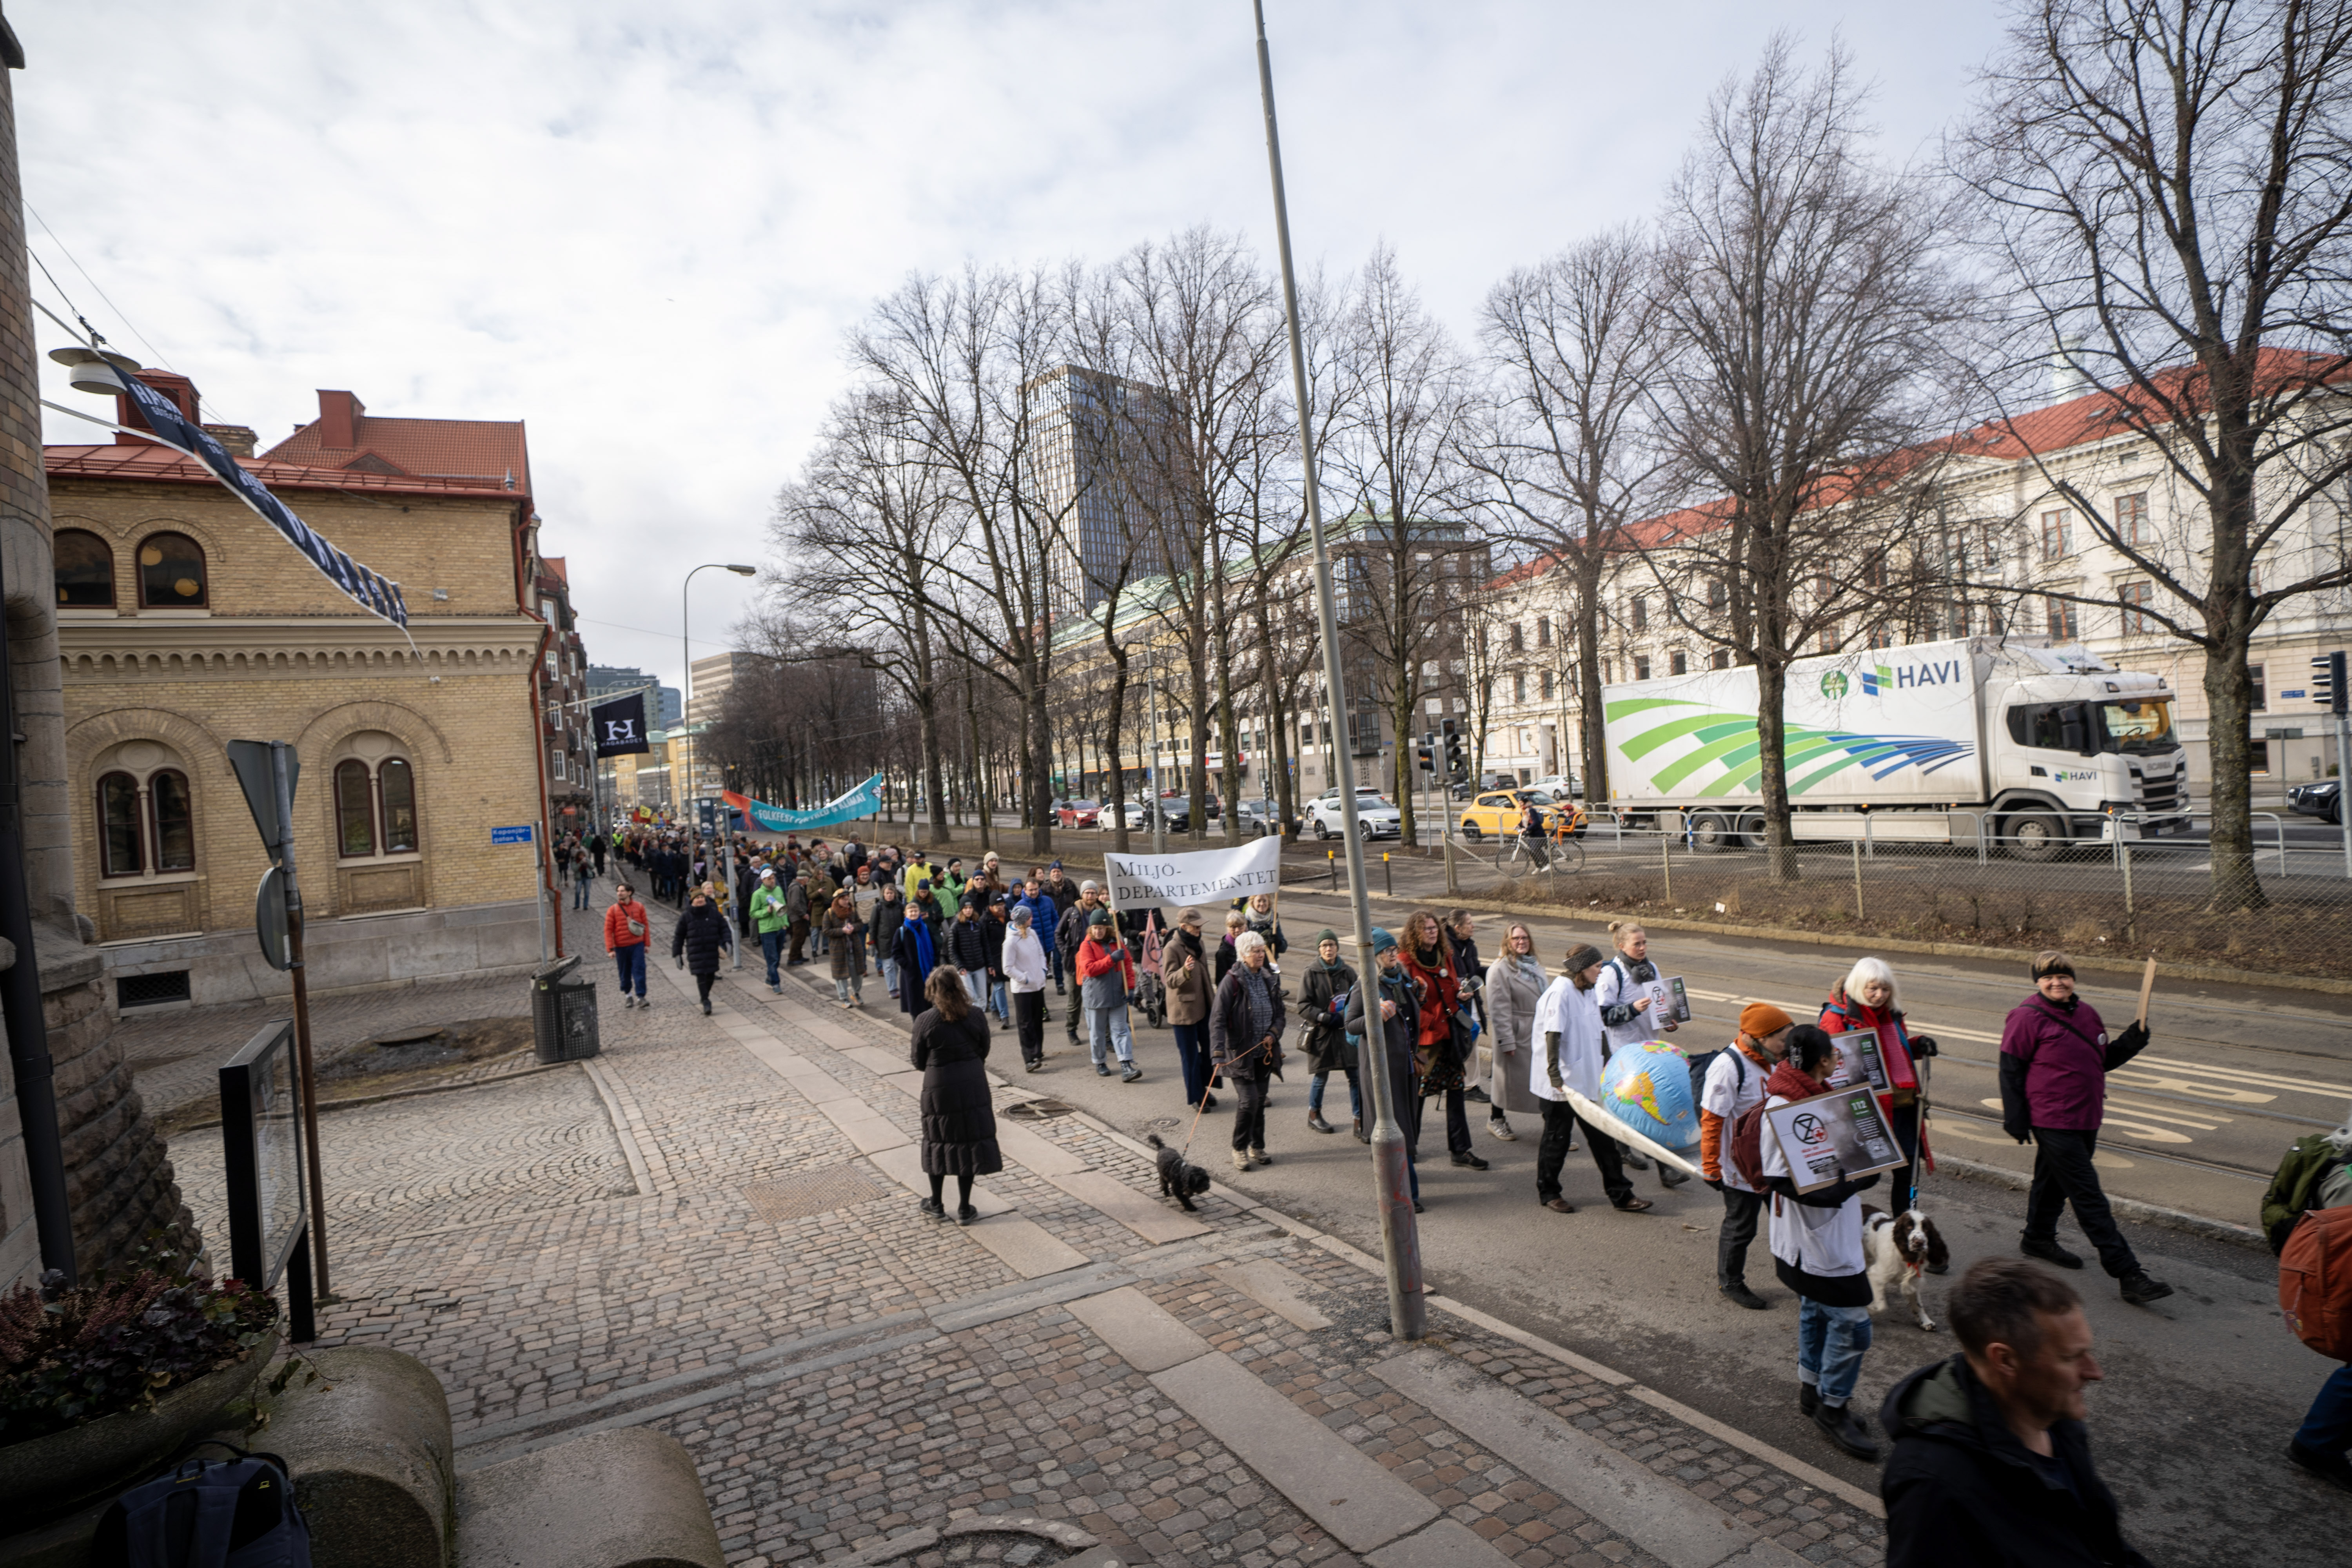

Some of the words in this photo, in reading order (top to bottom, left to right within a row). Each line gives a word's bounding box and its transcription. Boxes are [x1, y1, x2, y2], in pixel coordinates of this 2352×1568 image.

[1898, 660, 1960, 688] HAVI
[2071, 771, 2097, 780] HAVI
[838, 792, 866, 810] KLIMAT
[1118, 869, 1276, 900] DEPARTEMENTET
[1851, 1100, 1867, 1111] 112
